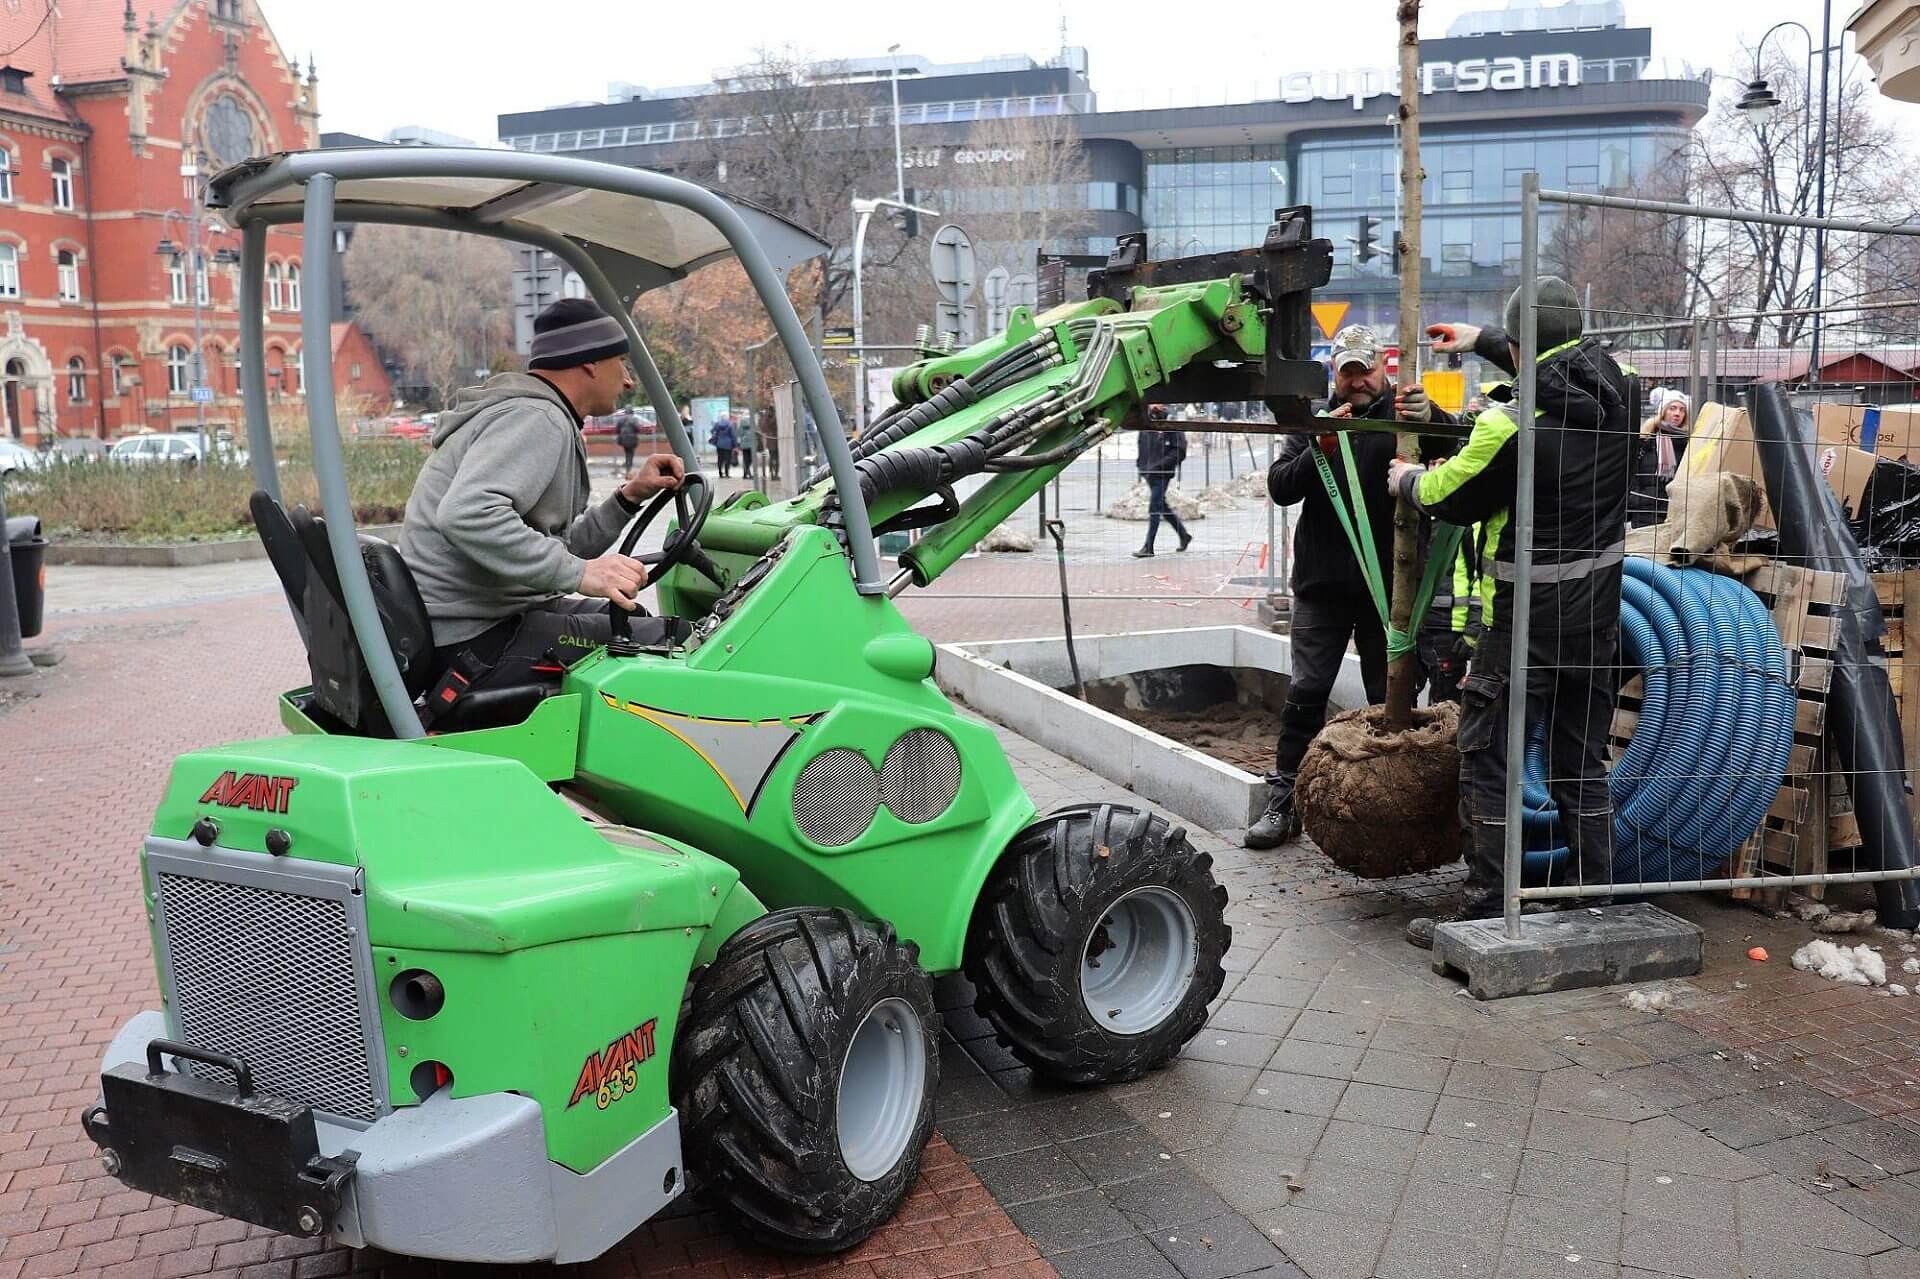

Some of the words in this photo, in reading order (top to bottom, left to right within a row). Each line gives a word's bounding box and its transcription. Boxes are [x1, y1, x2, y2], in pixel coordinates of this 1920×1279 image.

[954, 150, 1025, 164] GROUPON
[199, 770, 297, 814] AVANT
[564, 1017, 658, 1111] AVANT
[596, 1060, 638, 1110] 635
